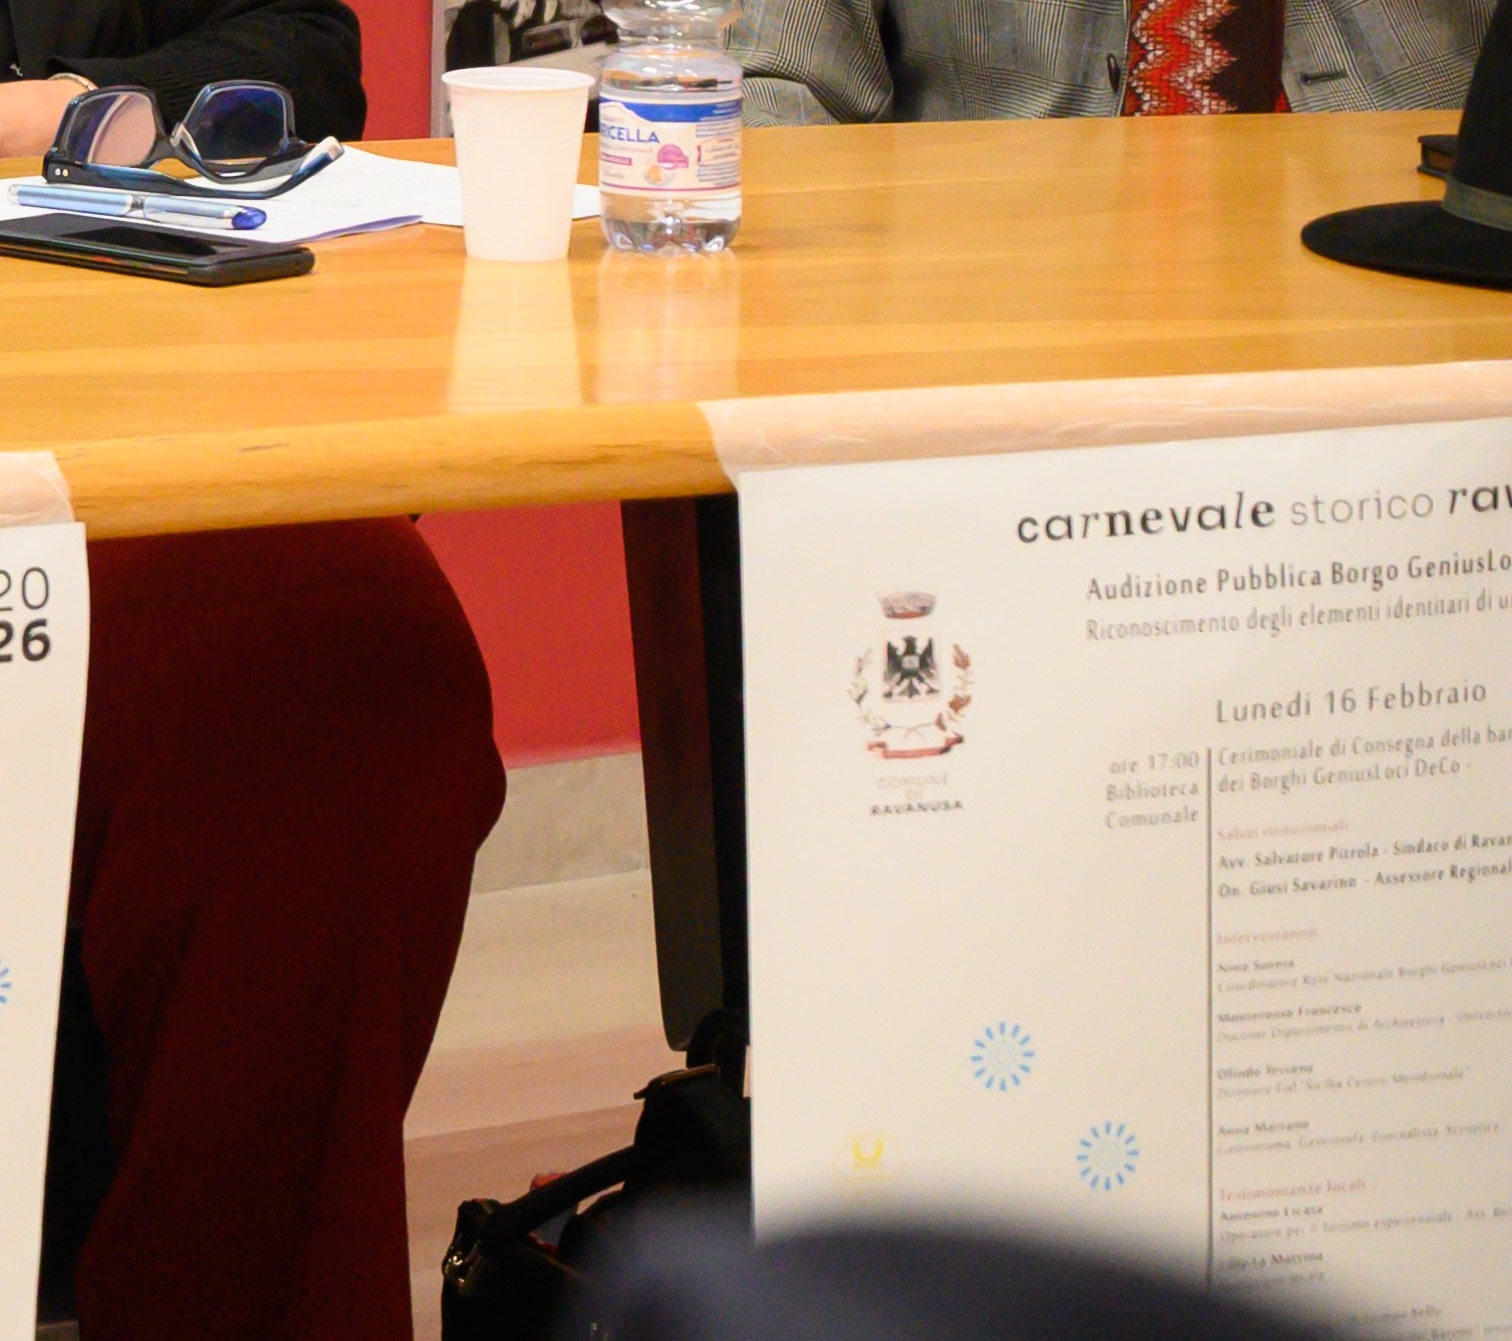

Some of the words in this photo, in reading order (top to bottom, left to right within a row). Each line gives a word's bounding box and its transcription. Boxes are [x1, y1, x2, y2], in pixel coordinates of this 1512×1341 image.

[1017, 491, 1276, 544] carnevale
[1290, 487, 1434, 526] storico
[1086, 572, 1207, 601] Audizione
[1216, 561, 1323, 594] Pubblica
[1331, 561, 1399, 591] Borgo
[1085, 614, 1240, 642] Riconoscimento
[1246, 604, 1293, 638] degli
[1300, 603, 1381, 627] elementi
[1386, 595, 1470, 619] identitari
[1476, 588, 1493, 612] di
[1324, 688, 1357, 715] 16
[1367, 679, 1487, 711] Febbraio
[1217, 738, 1324, 766] Cerimoniale
[1329, 738, 1347, 757] di
[1350, 730, 1435, 761] Consegna
[1440, 725, 1482, 748] della
[1104, 780, 1200, 802] Biblioteca
[1217, 773, 1244, 793] dei
[1249, 768, 1307, 794] Borghi
[1104, 806, 1200, 830] Comunale
